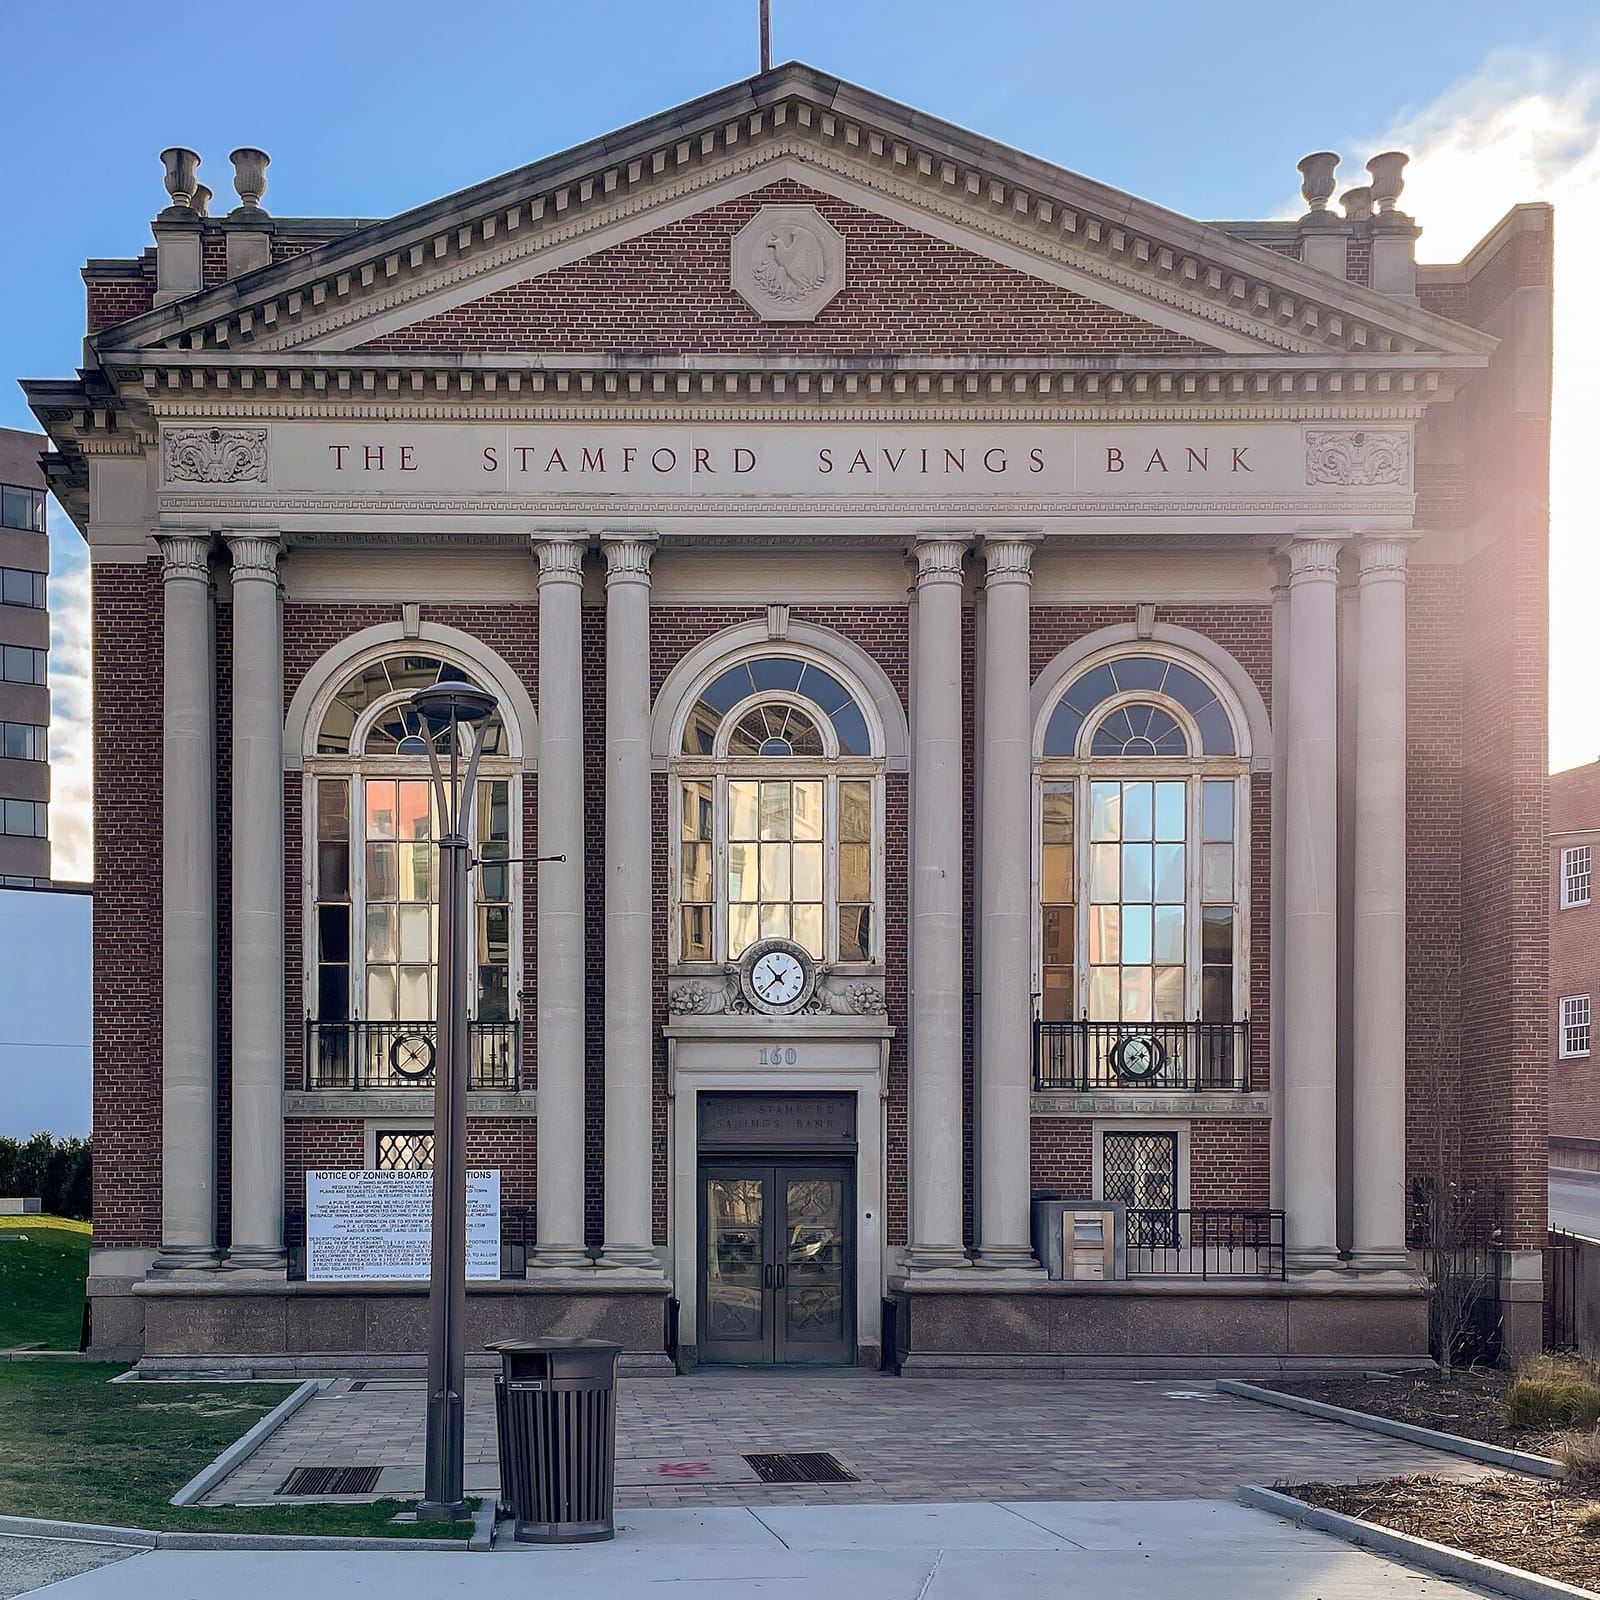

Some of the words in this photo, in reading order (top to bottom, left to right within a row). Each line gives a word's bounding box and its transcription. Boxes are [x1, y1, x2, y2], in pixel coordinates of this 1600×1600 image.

[328, 445, 418, 472] THE
[482, 446, 757, 474] STAMFORD
[818, 447, 1045, 474] SAVINGS
[1106, 446, 1254, 474] BANK
[759, 1047, 797, 1065] 160
[716, 1104, 743, 1115] THE
[758, 1104, 834, 1115] STAMFORD
[716, 1119, 781, 1129] SAVINGS
[796, 1119, 834, 1129] BANK
[315, 1171, 347, 1180] NOTICE
[349, 1171, 361, 1180] OF
[362, 1171, 396, 1180] ZONING
[397, 1171, 429, 1180] BOARD
